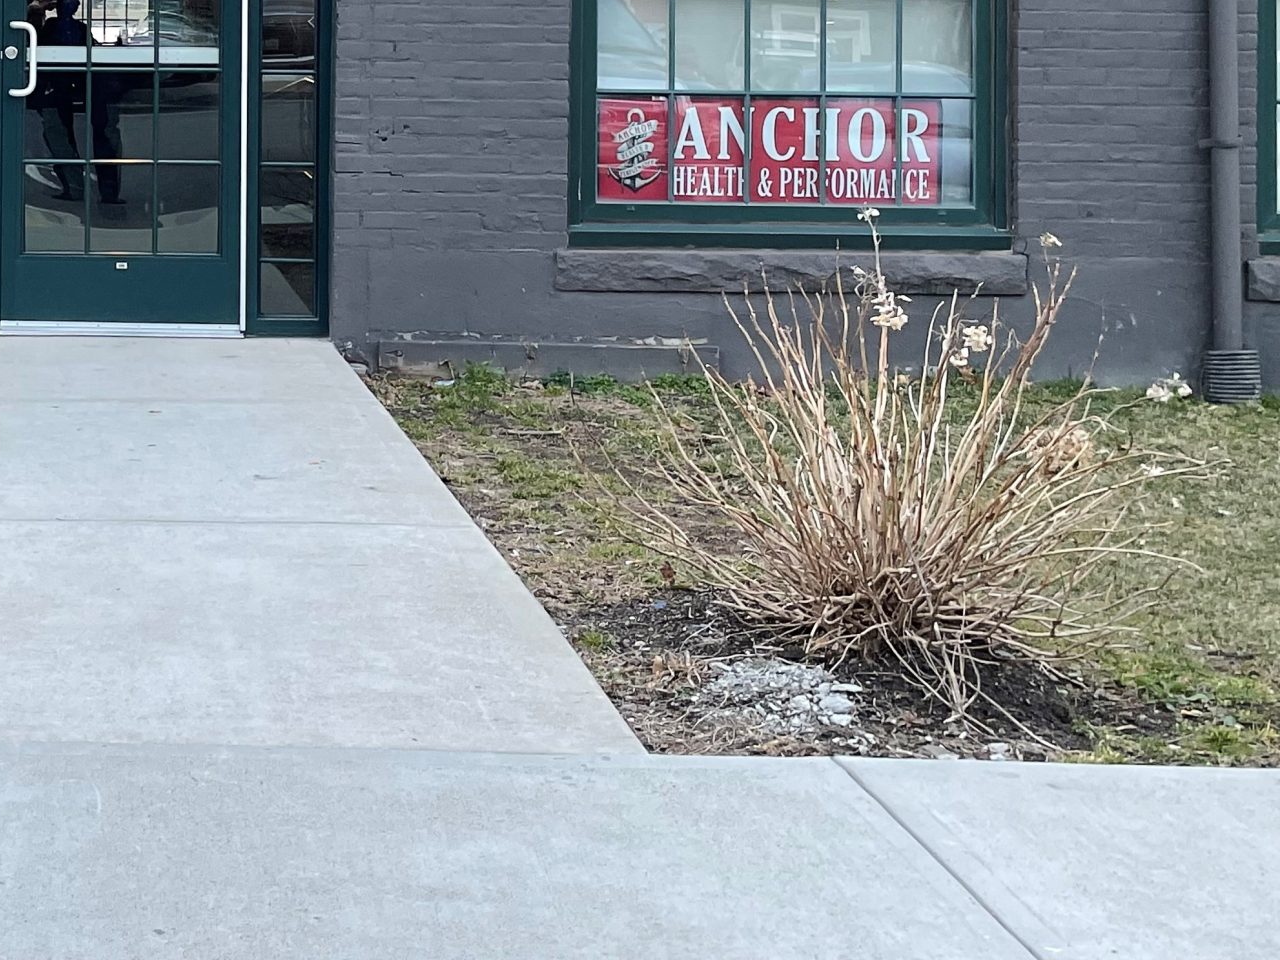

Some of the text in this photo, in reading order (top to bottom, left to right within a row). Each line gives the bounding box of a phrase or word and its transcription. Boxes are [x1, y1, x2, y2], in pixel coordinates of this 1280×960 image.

[673, 106, 931, 163] ANCHOR
[673, 166, 746, 197] HEALTH
[757, 167, 773, 198] &
